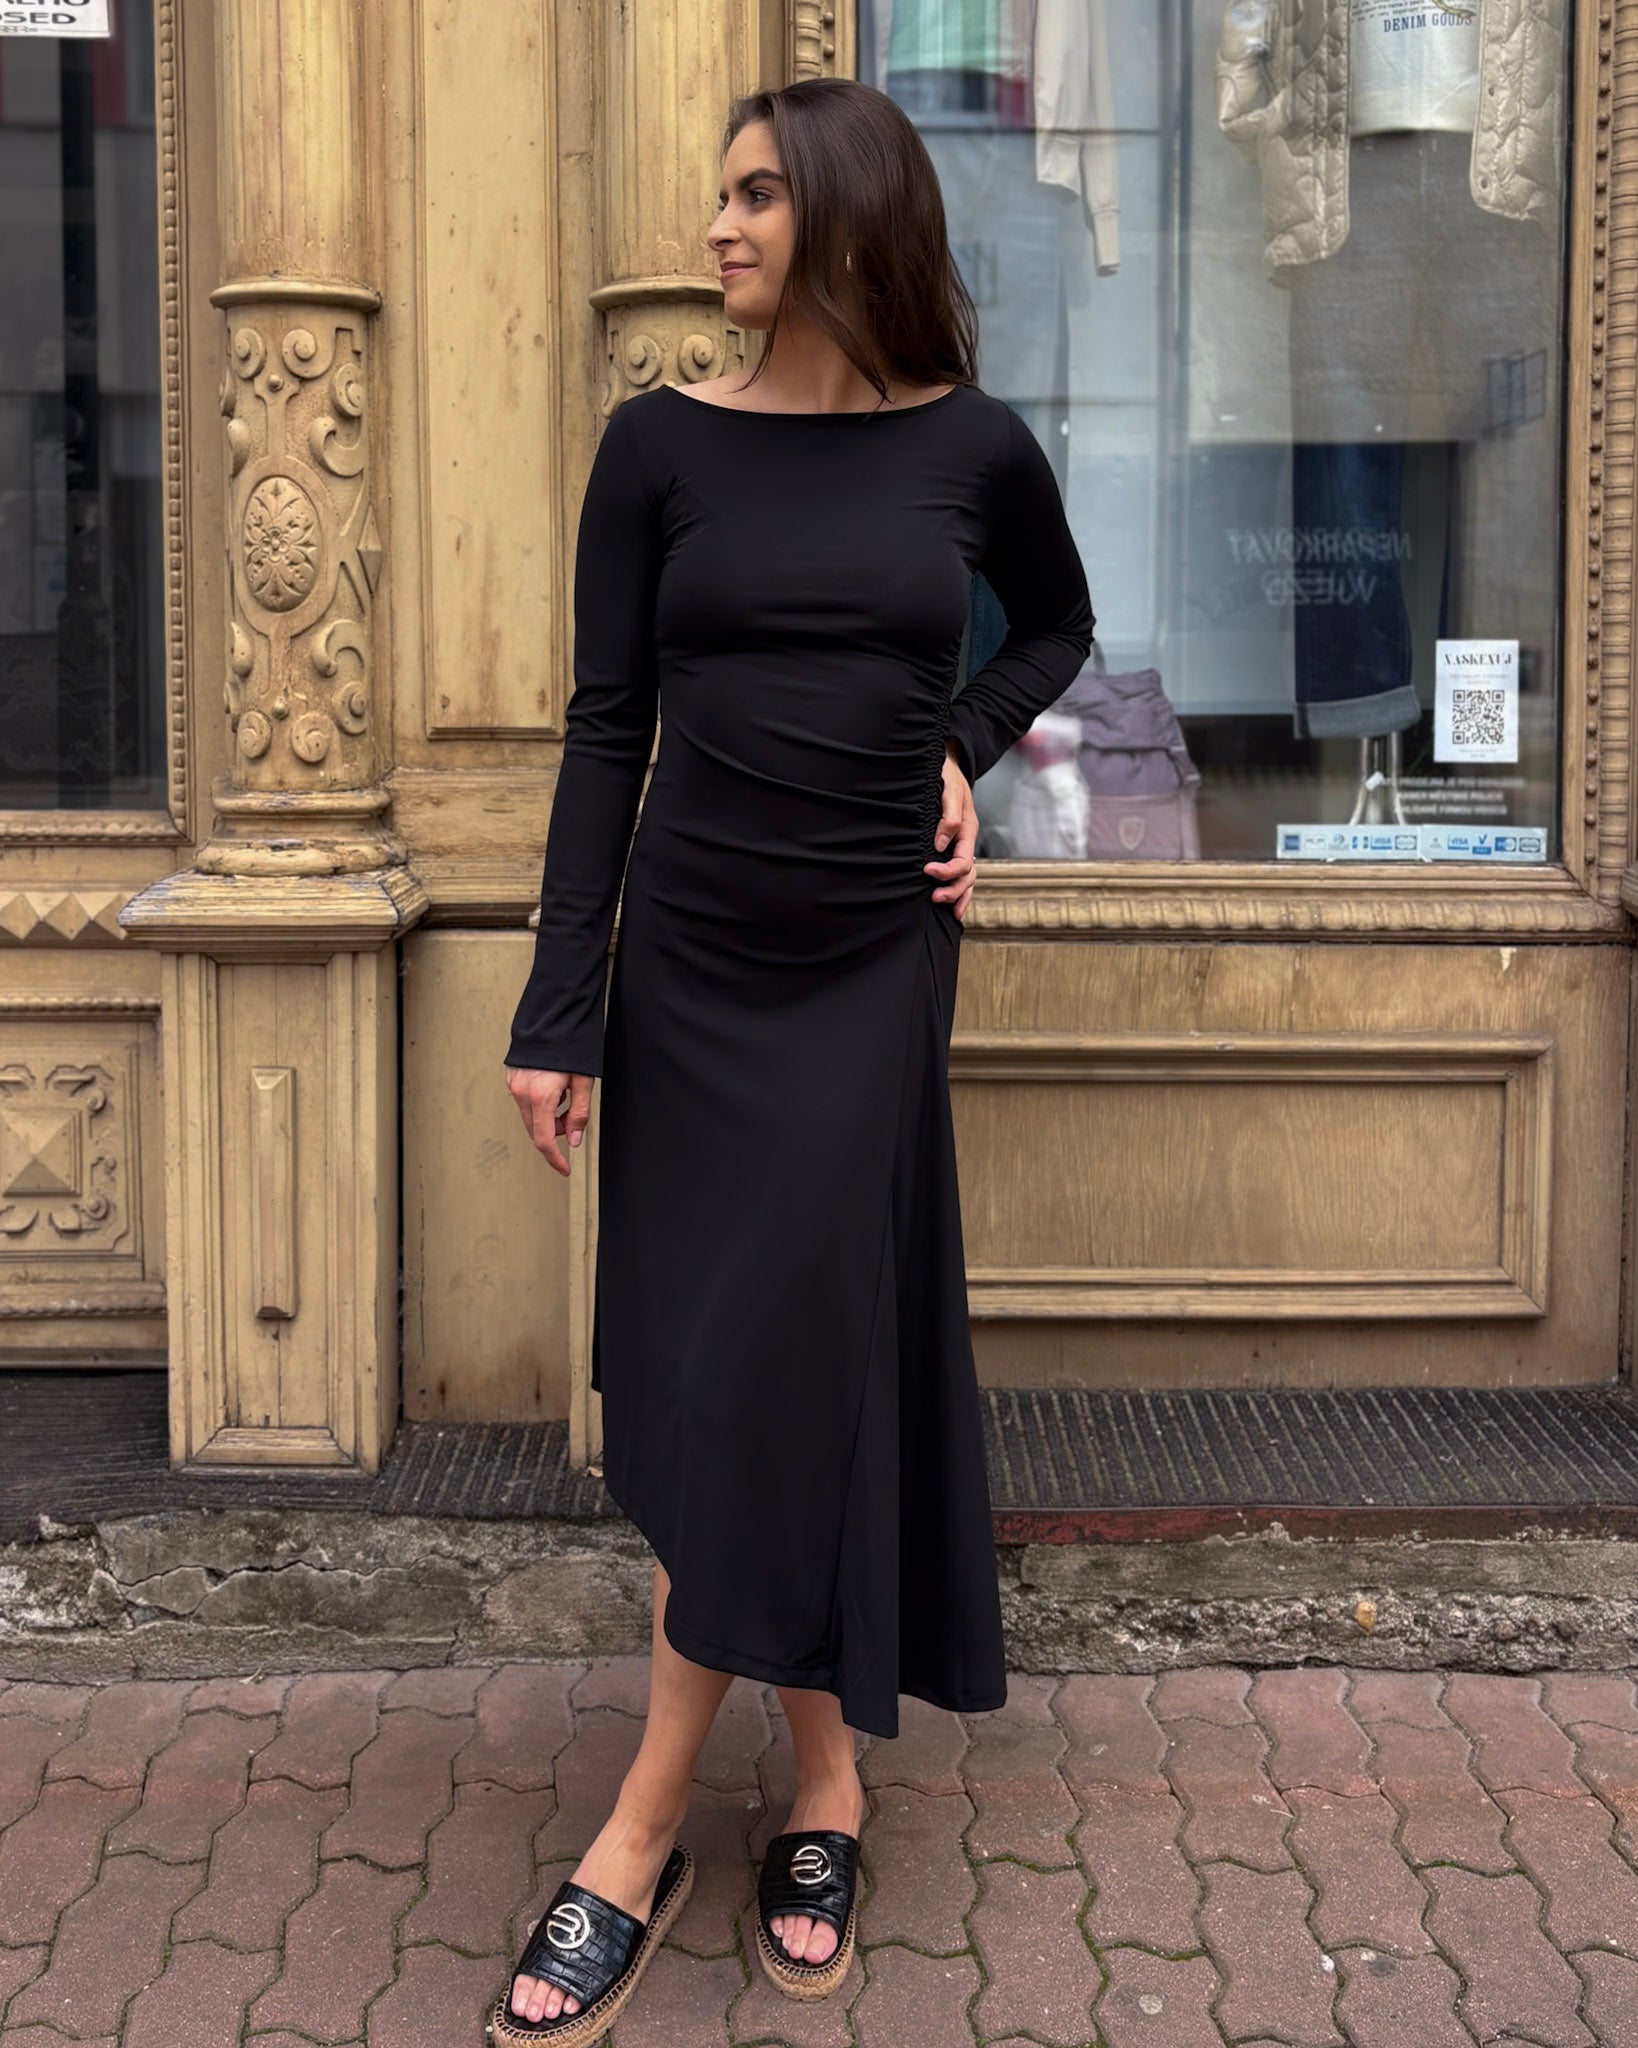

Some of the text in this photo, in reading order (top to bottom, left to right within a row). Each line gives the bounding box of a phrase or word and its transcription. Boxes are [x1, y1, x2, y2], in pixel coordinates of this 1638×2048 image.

[0, 12, 77, 24] SED
[1384, 15, 1426, 32] DENIM
[1451, 837, 1468, 845] VISA
